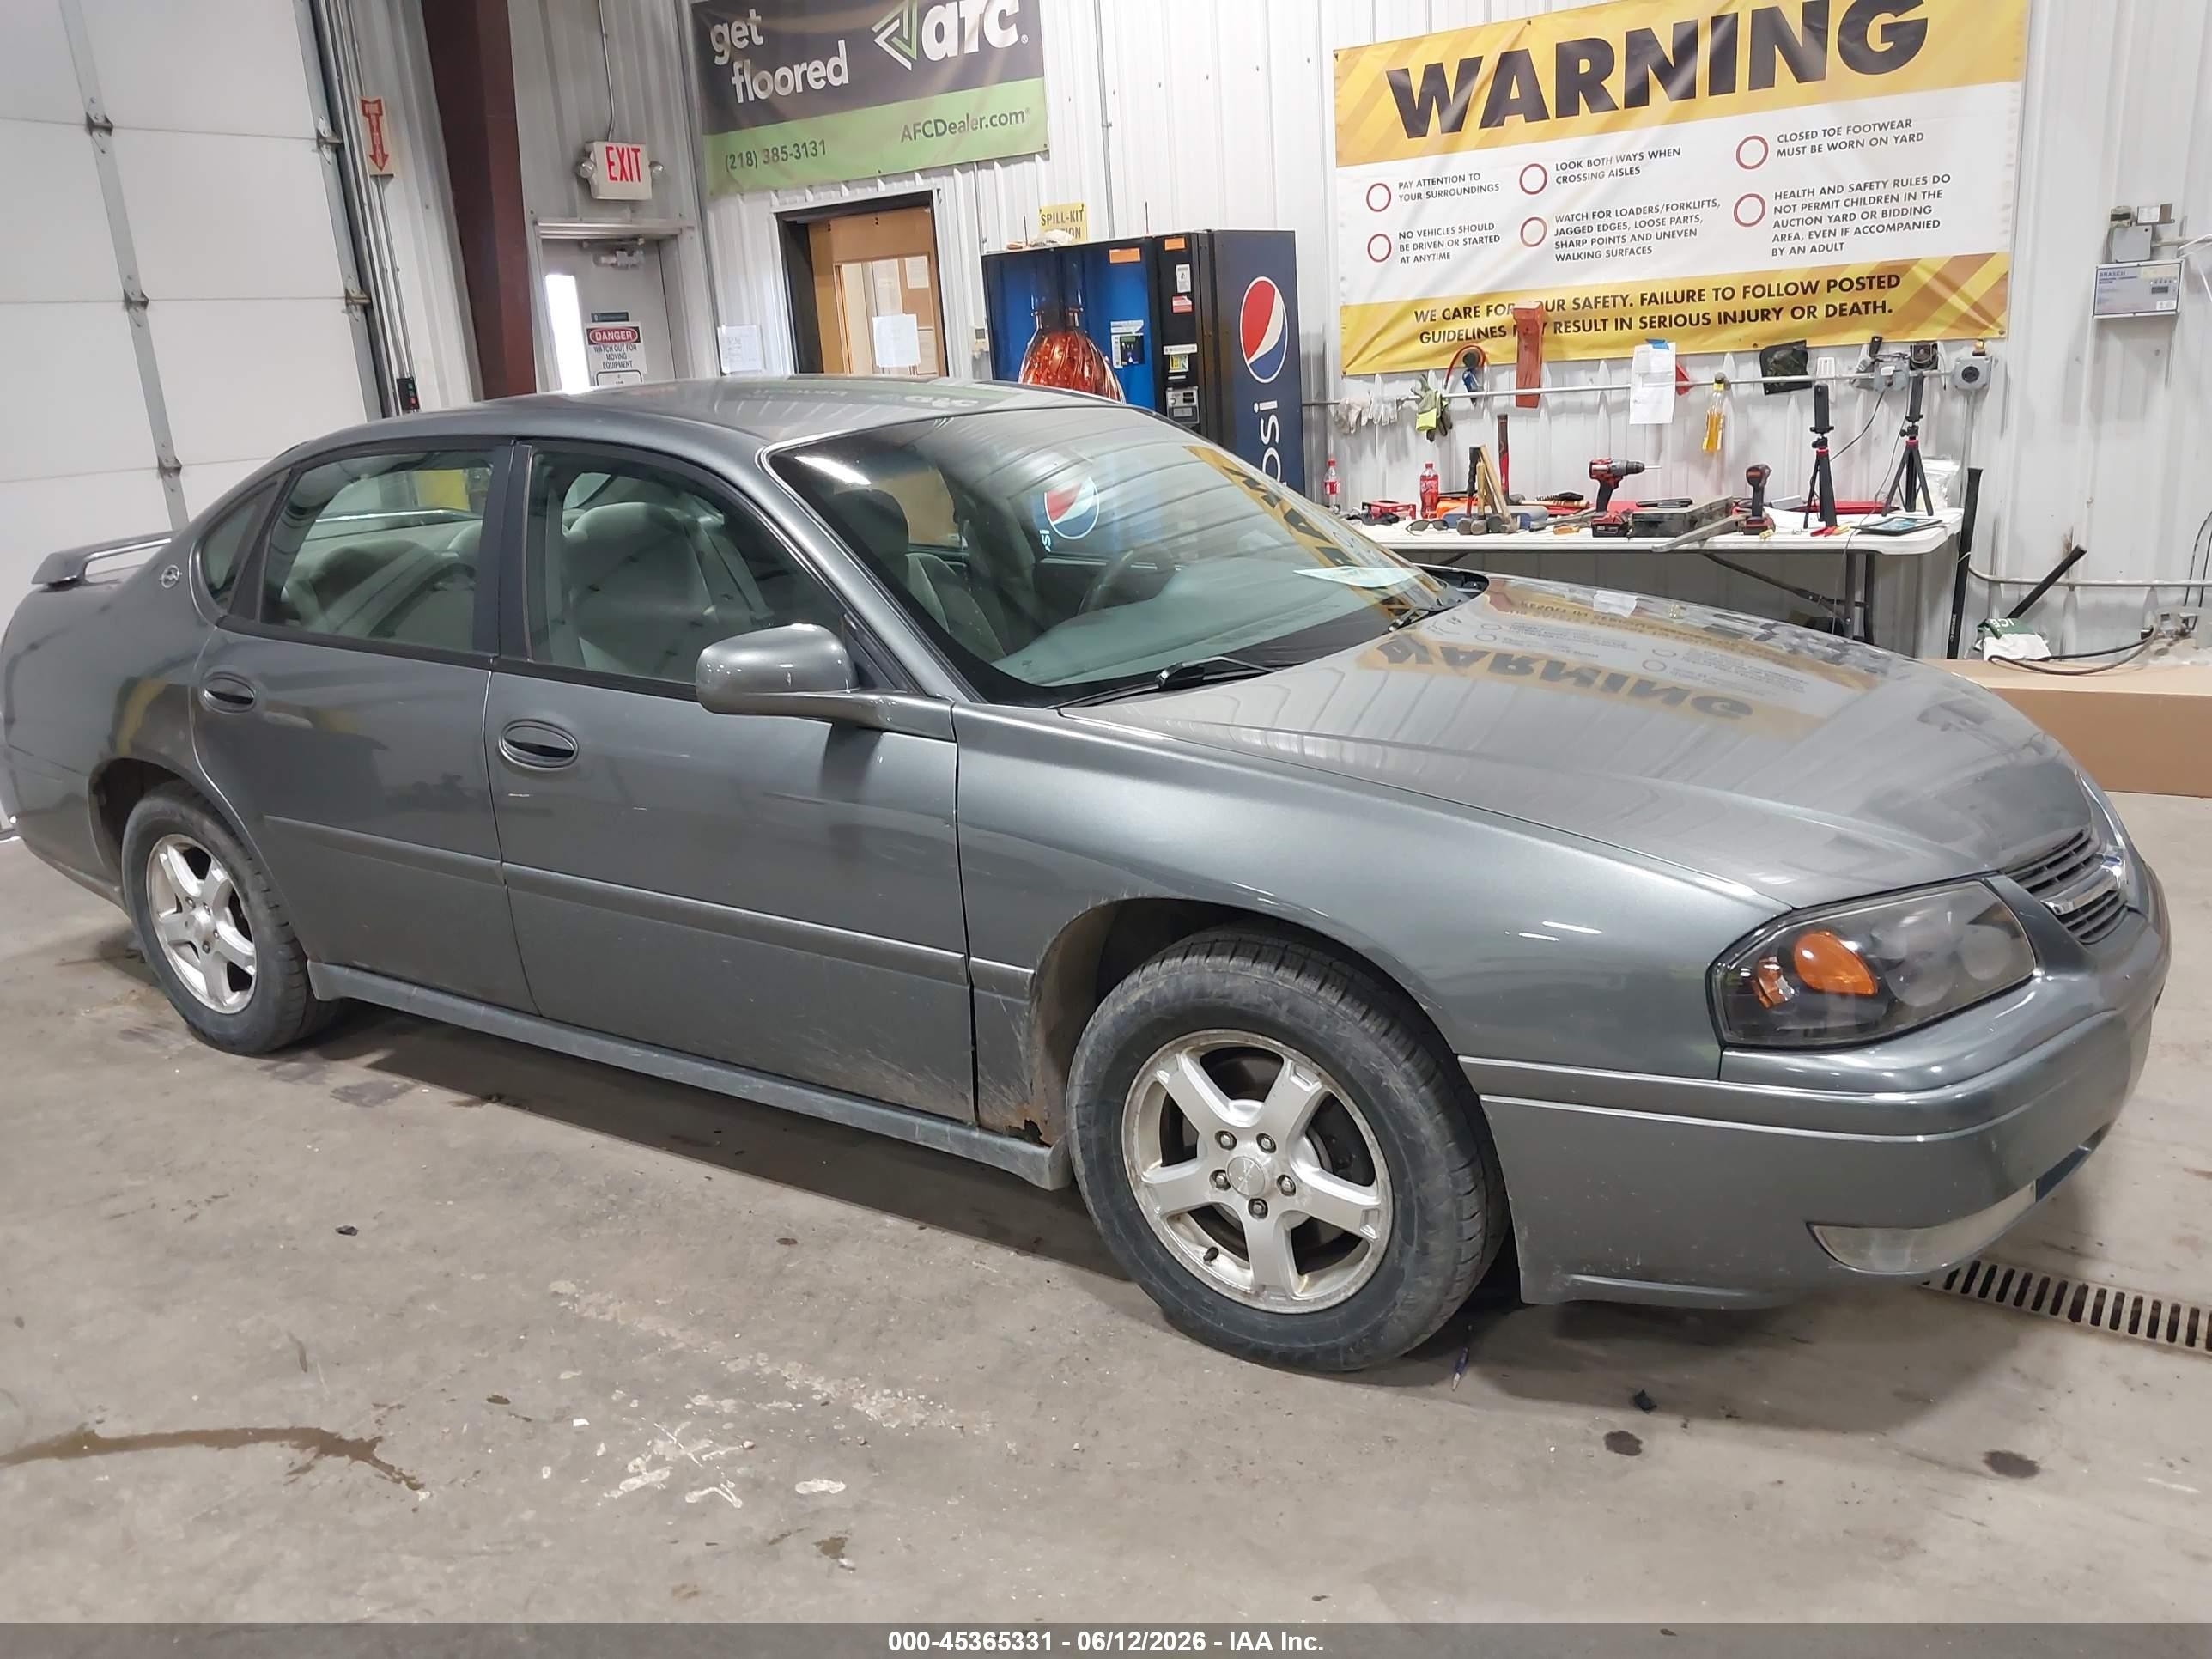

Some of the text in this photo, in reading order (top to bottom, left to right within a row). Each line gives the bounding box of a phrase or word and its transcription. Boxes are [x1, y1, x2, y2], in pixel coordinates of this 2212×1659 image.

[710, 9, 763, 65] get
[732, 40, 849, 104] floored
[1385, 0, 1929, 139] WARNING
[901, 112, 1025, 143] AFCDealer.com
[1778, 118, 1912, 143] CLOSED TOE FOOTWEAR
[725, 139, 827, 173] (218) 385-3131
[1777, 132, 1924, 158] MUST BE WORN ON YARD
[605, 146, 641, 183] EXIT
[1556, 147, 1680, 171] LOOK BOTH WAYS WHEN
[1398, 173, 1481, 190] PAY ATTENTION TO
[1556, 166, 1641, 185] CROSSING AISLES
[1774, 173, 1951, 201] HEALTH AND SAFETY RULES DO
[1399, 183, 1500, 202] YOUR SURROUNDINGS
[1773, 189, 1943, 215] NOT PERMIT CHILDREN IN THE
[1041, 209, 1085, 226] SPILL-KIT
[1555, 198, 1721, 223] WATCH FOR LOADERS/FORKLIFTS,
[1772, 205, 1932, 229] AUCTION YARD OR BIDDING
[1399, 222, 1495, 240] NO VEHICLES SHOULD
[1554, 214, 1704, 237] JAGGED EDGES, LOOSE PARTS,
[1772, 219, 1941, 243] AREA, EVEN IF ACCOMPANIED
[1400, 234, 1500, 252] BE DRIVEN OR STARTED
[1555, 228, 1698, 250] SHARP POINTS AND UNEVEN
[1771, 242, 1845, 257] BY AN ADULT
[1401, 252, 1450, 264] AT ANYTIME
[1555, 246, 1653, 262] WALKING SURFACES
[1414, 309, 1437, 323] WE
[1442, 305, 1480, 320] CARE
[1572, 294, 1634, 310] SAFETY.
[1639, 288, 1706, 306] FAILURE
[1712, 287, 1735, 301] TO
[1742, 280, 1820, 300] FOLLOW
[1826, 274, 1901, 293] POSTED
[1419, 325, 1507, 344] GUIDELINES
[1553, 318, 1609, 334] RESULT
[1614, 316, 1632, 331] IN
[1638, 312, 1711, 330] SERIOUS
[1717, 307, 1784, 325] INJURY
[1790, 304, 1817, 319] OR
[1825, 300, 1893, 318] DEATH.
[595, 331, 633, 341] DANGER
[614, 343, 625, 352] OUT
[602, 361, 633, 369] EQUIPMENT
